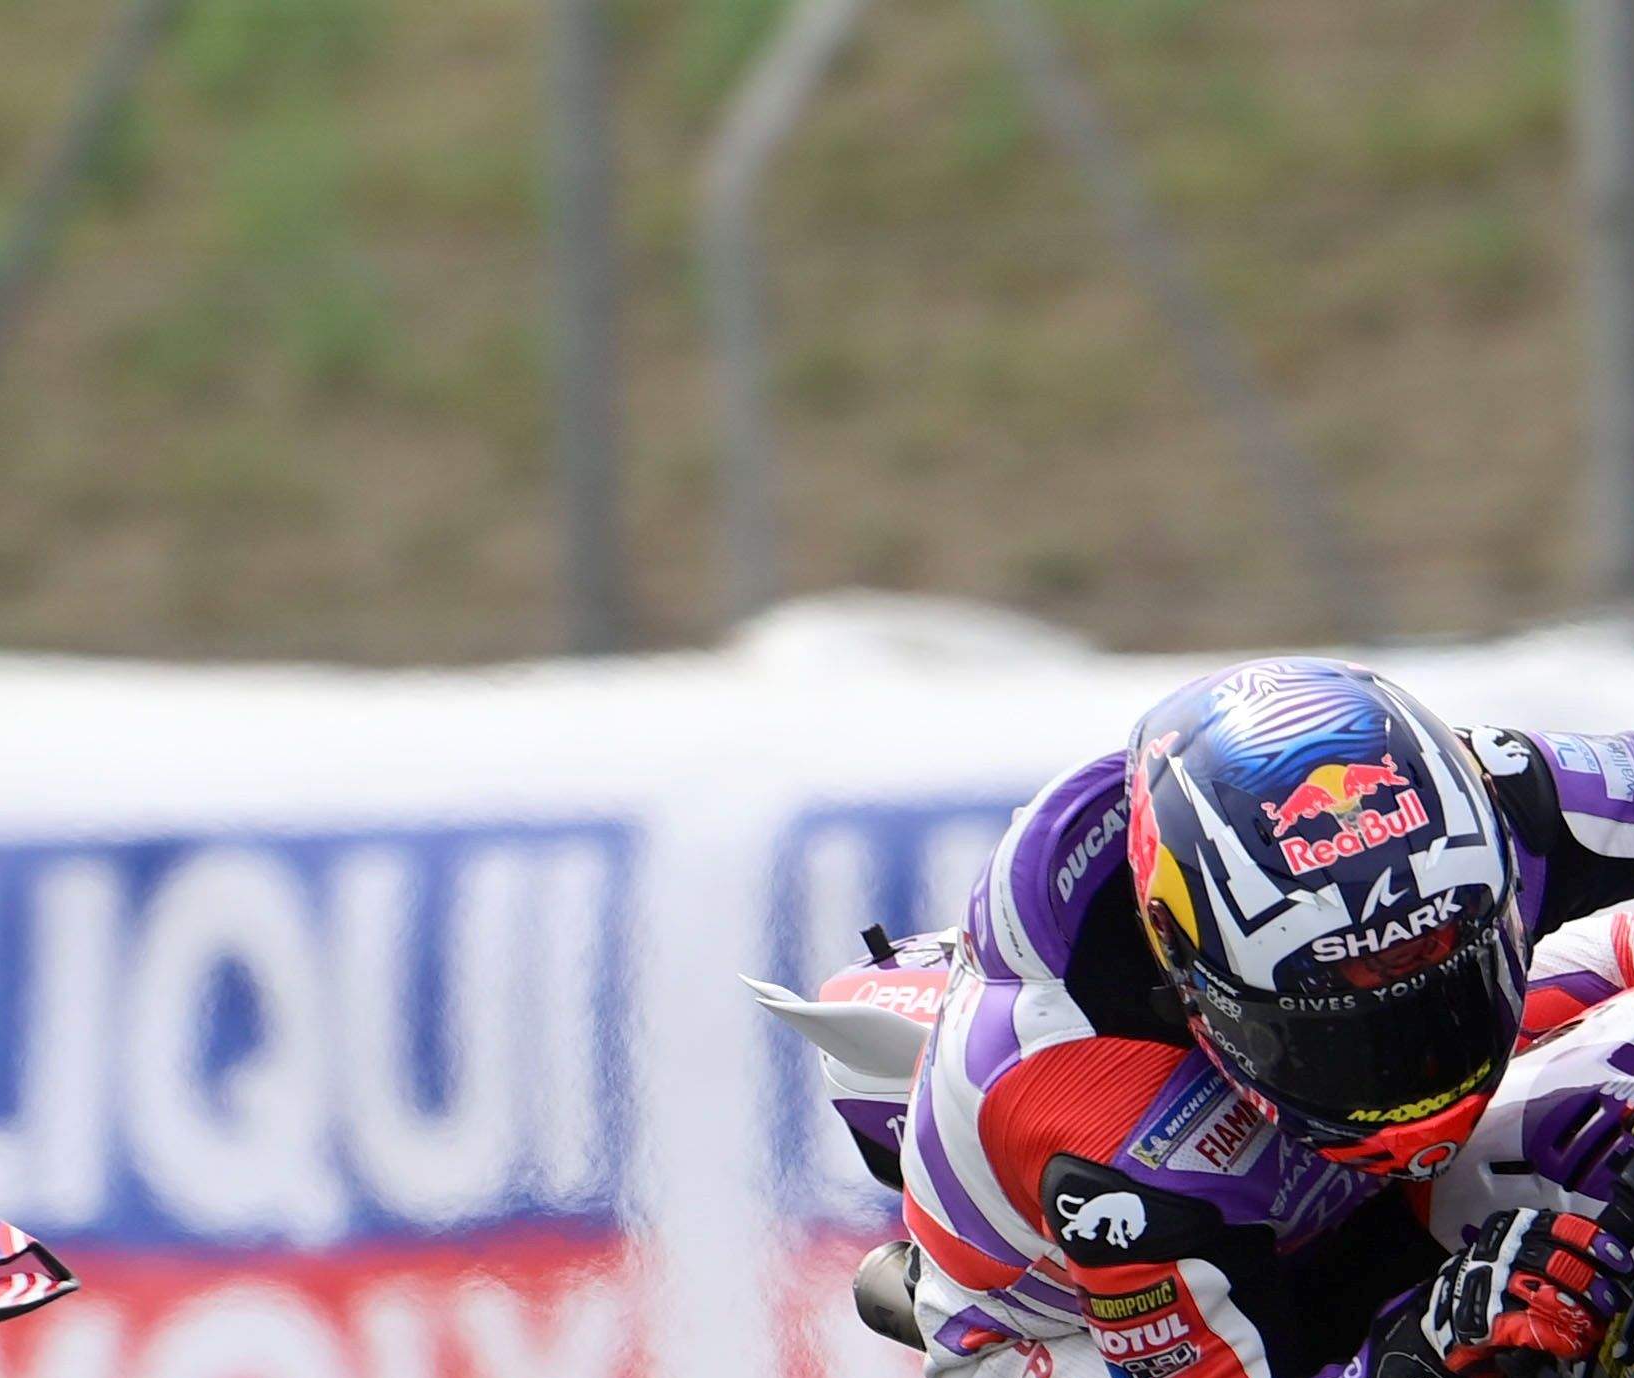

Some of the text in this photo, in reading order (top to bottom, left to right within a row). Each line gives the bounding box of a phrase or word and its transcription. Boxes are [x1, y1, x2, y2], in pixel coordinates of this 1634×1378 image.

[1056, 798, 1131, 903] DUCAT
[1279, 788, 1430, 875] Red Bull
[1311, 889, 1463, 962] SHARK
[1279, 994, 1356, 1011] GIVES
[1373, 973, 1426, 1002] YOU
[1091, 1313, 1189, 1354] MOTUL
